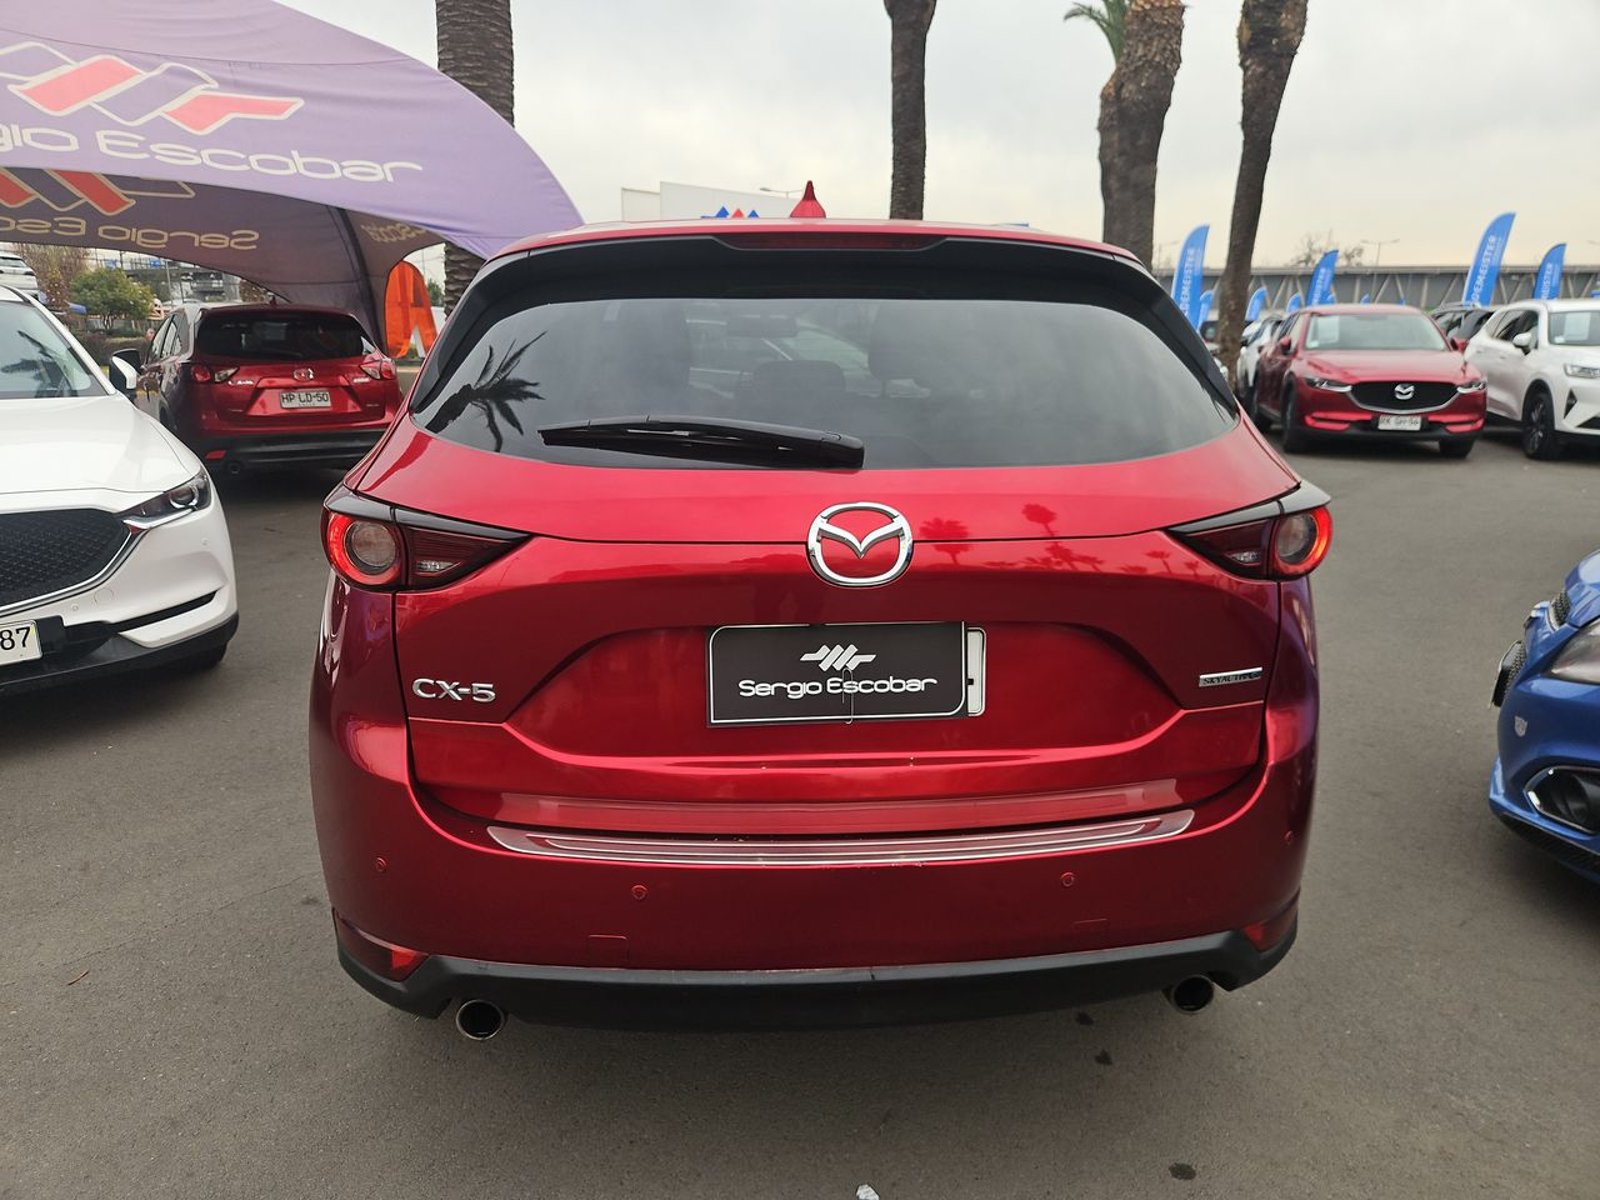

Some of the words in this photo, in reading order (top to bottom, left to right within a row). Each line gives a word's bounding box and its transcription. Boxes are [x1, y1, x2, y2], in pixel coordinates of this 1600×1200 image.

[96, 129, 423, 182] Escobar
[412, 678, 496, 702] CX-5
[738, 679, 822, 699] Sergio
[826, 675, 938, 695] Escobar
